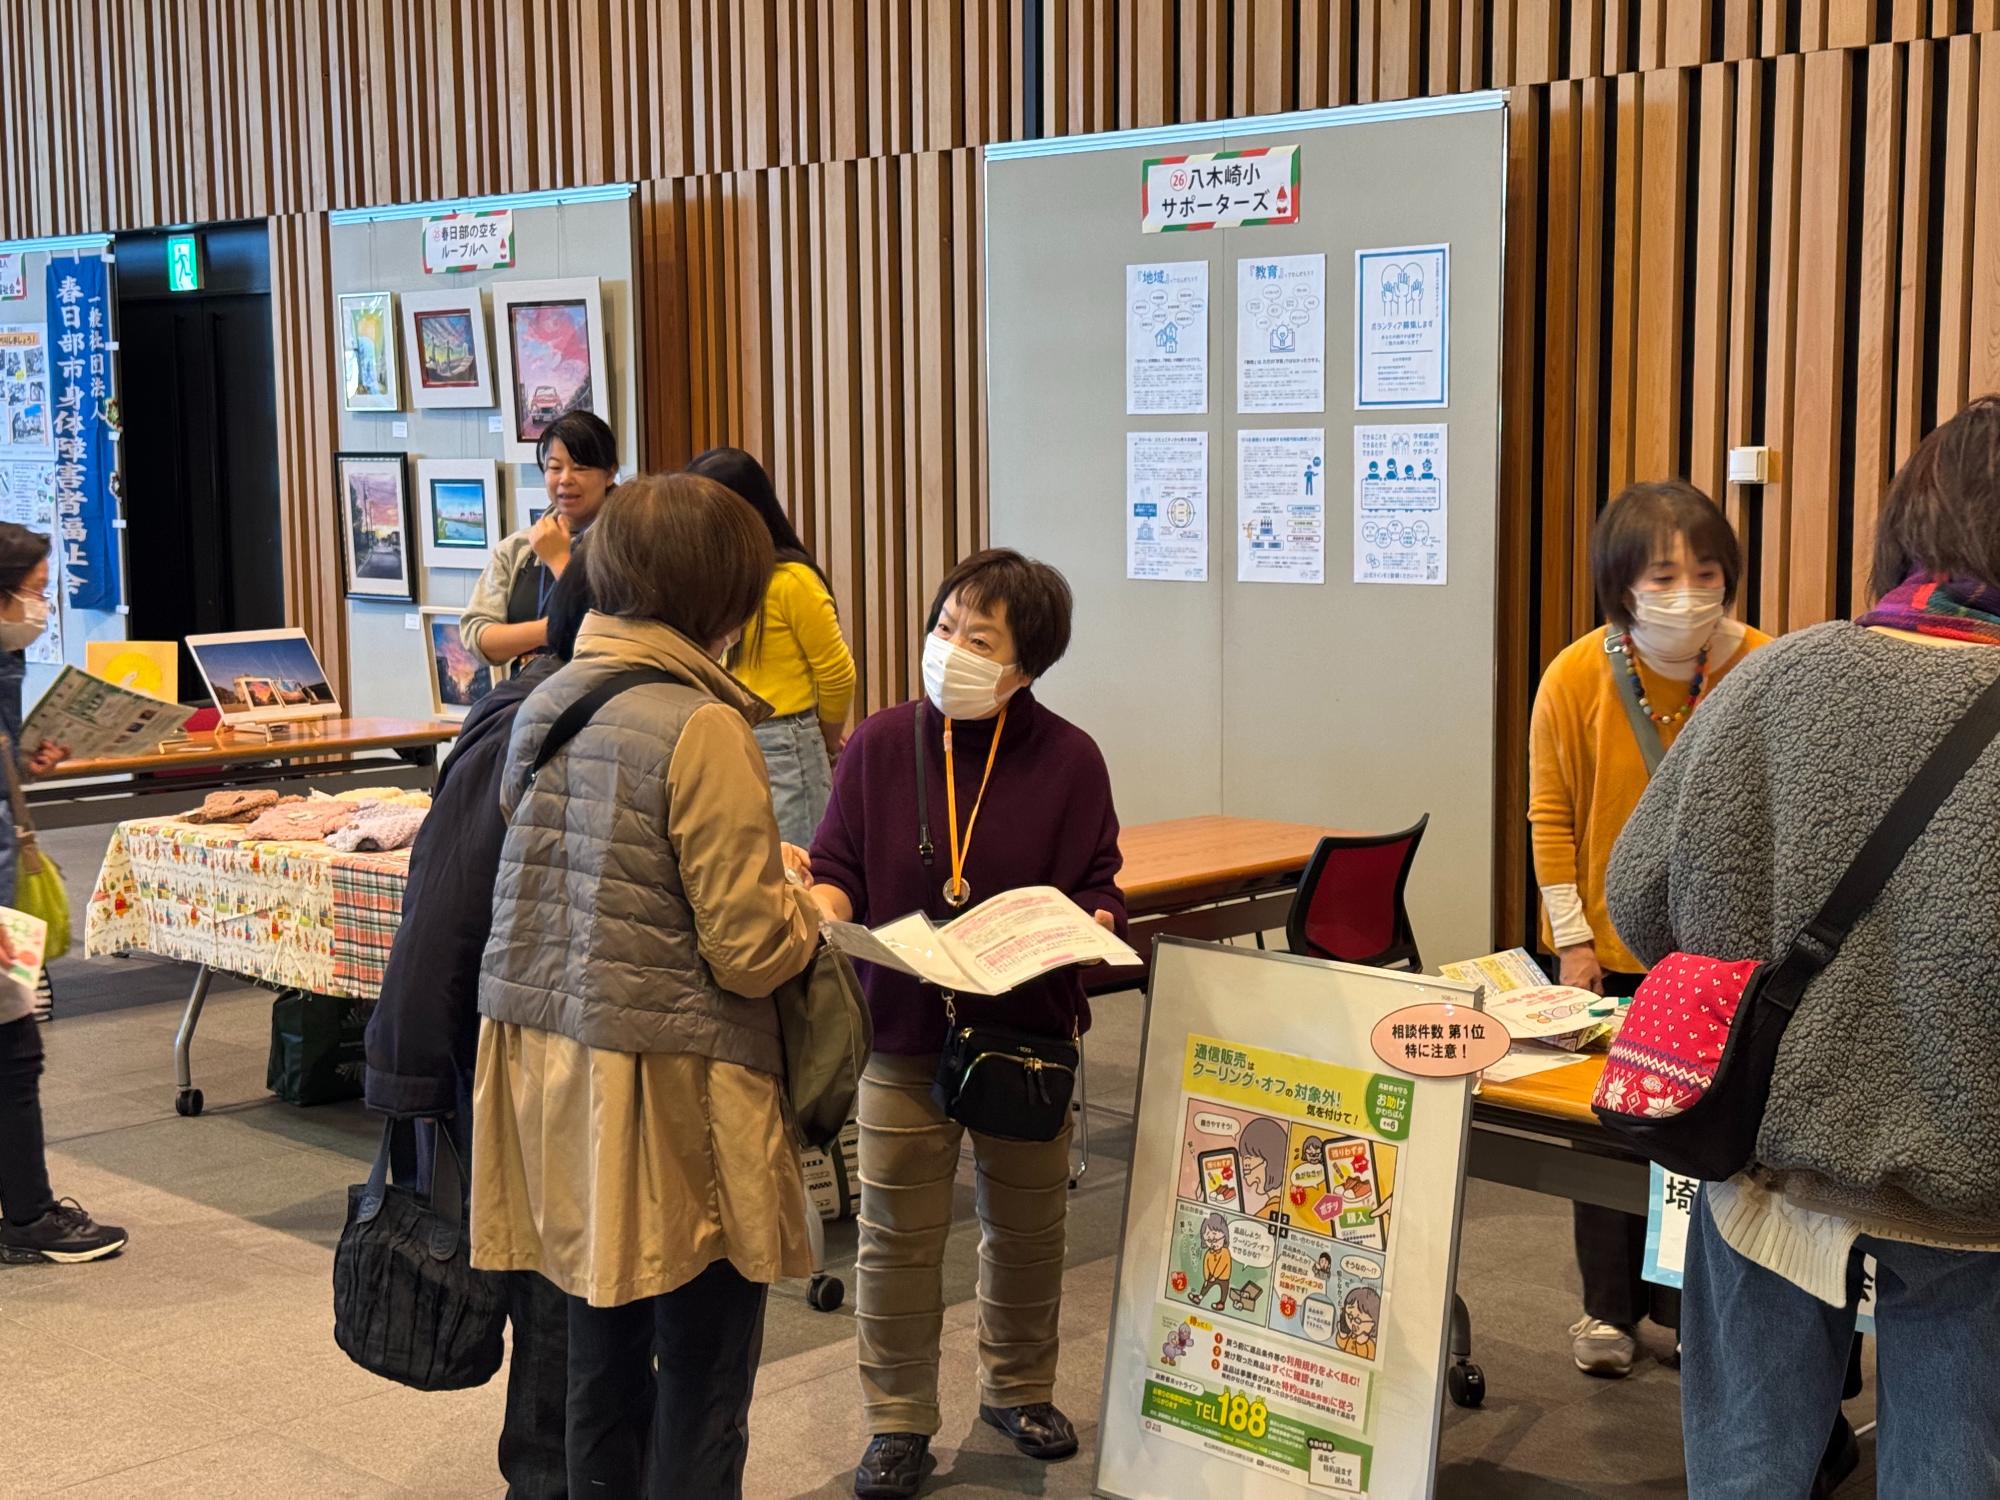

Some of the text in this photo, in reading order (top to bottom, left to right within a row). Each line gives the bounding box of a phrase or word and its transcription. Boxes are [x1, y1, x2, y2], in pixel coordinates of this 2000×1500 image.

[1162, 189, 1270, 219] サポーターズ
[442, 243, 488, 259] ルーブルへ
[1392, 1024, 1485, 1040] 相談件数 第1位
[1194, 1043, 1255, 1071] 通信販売は
[1405, 1043, 1466, 1059] 特に注意!
[1193, 1061, 1342, 1107] クーリング・オフの対象外!
[1377, 1093, 1407, 1111] お助け
[1307, 1104, 1358, 1126] 気を付けて!
[1665, 1177, 1697, 1215] 埼
[1195, 1401, 1219, 1423] TEL
[1217, 1392, 1268, 1437] 188
